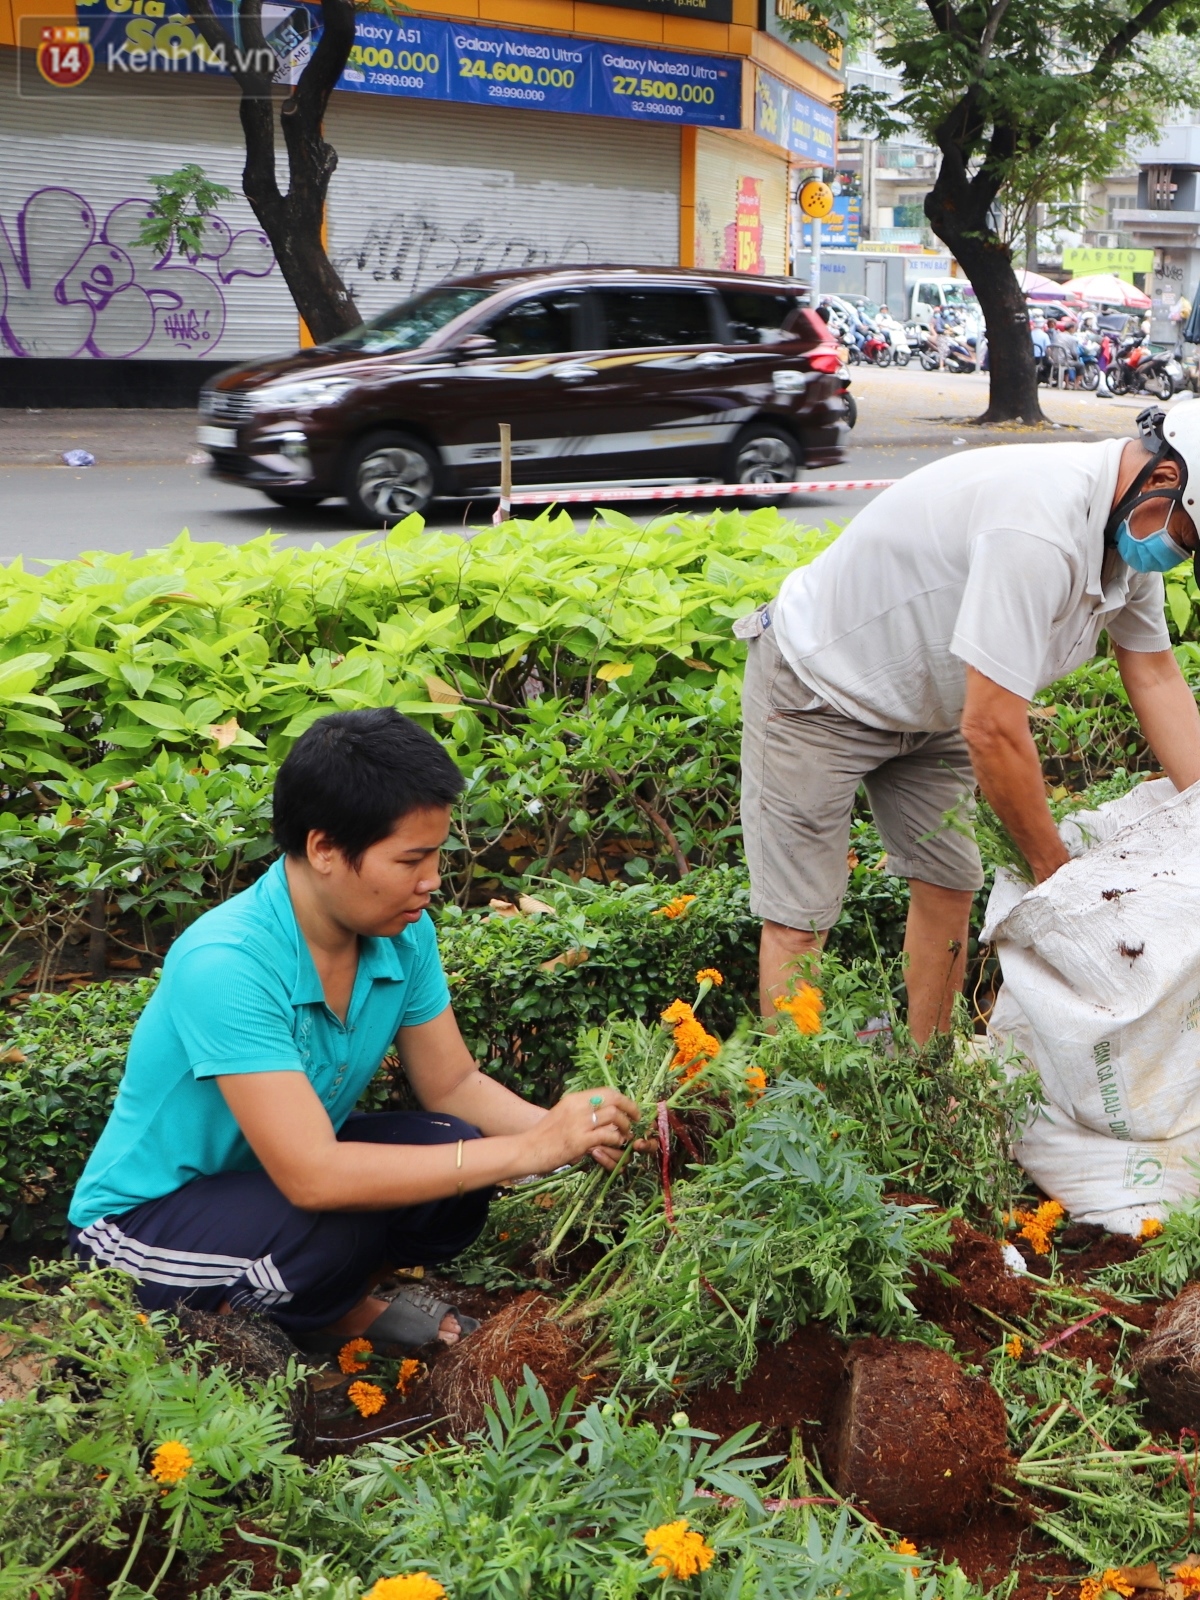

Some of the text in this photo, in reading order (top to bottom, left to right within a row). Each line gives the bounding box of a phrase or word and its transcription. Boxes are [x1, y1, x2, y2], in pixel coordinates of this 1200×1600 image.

[355, 23, 421, 44] alaxy A51
[454, 36, 582, 63] Galaxy Note20 Ultra
[459, 57, 574, 88] 24.600.000
[602, 54, 646, 74] Galaxy
[648, 60, 689, 76] Note20
[691, 65, 717, 80] Ultra
[368, 72, 424, 88] 7.990.000
[612, 75, 714, 104] 27.500.000
[488, 85, 545, 101] 29.990.000
[631, 101, 683, 115] 32.990.000
[1071, 250, 1136, 263] PASSIO
